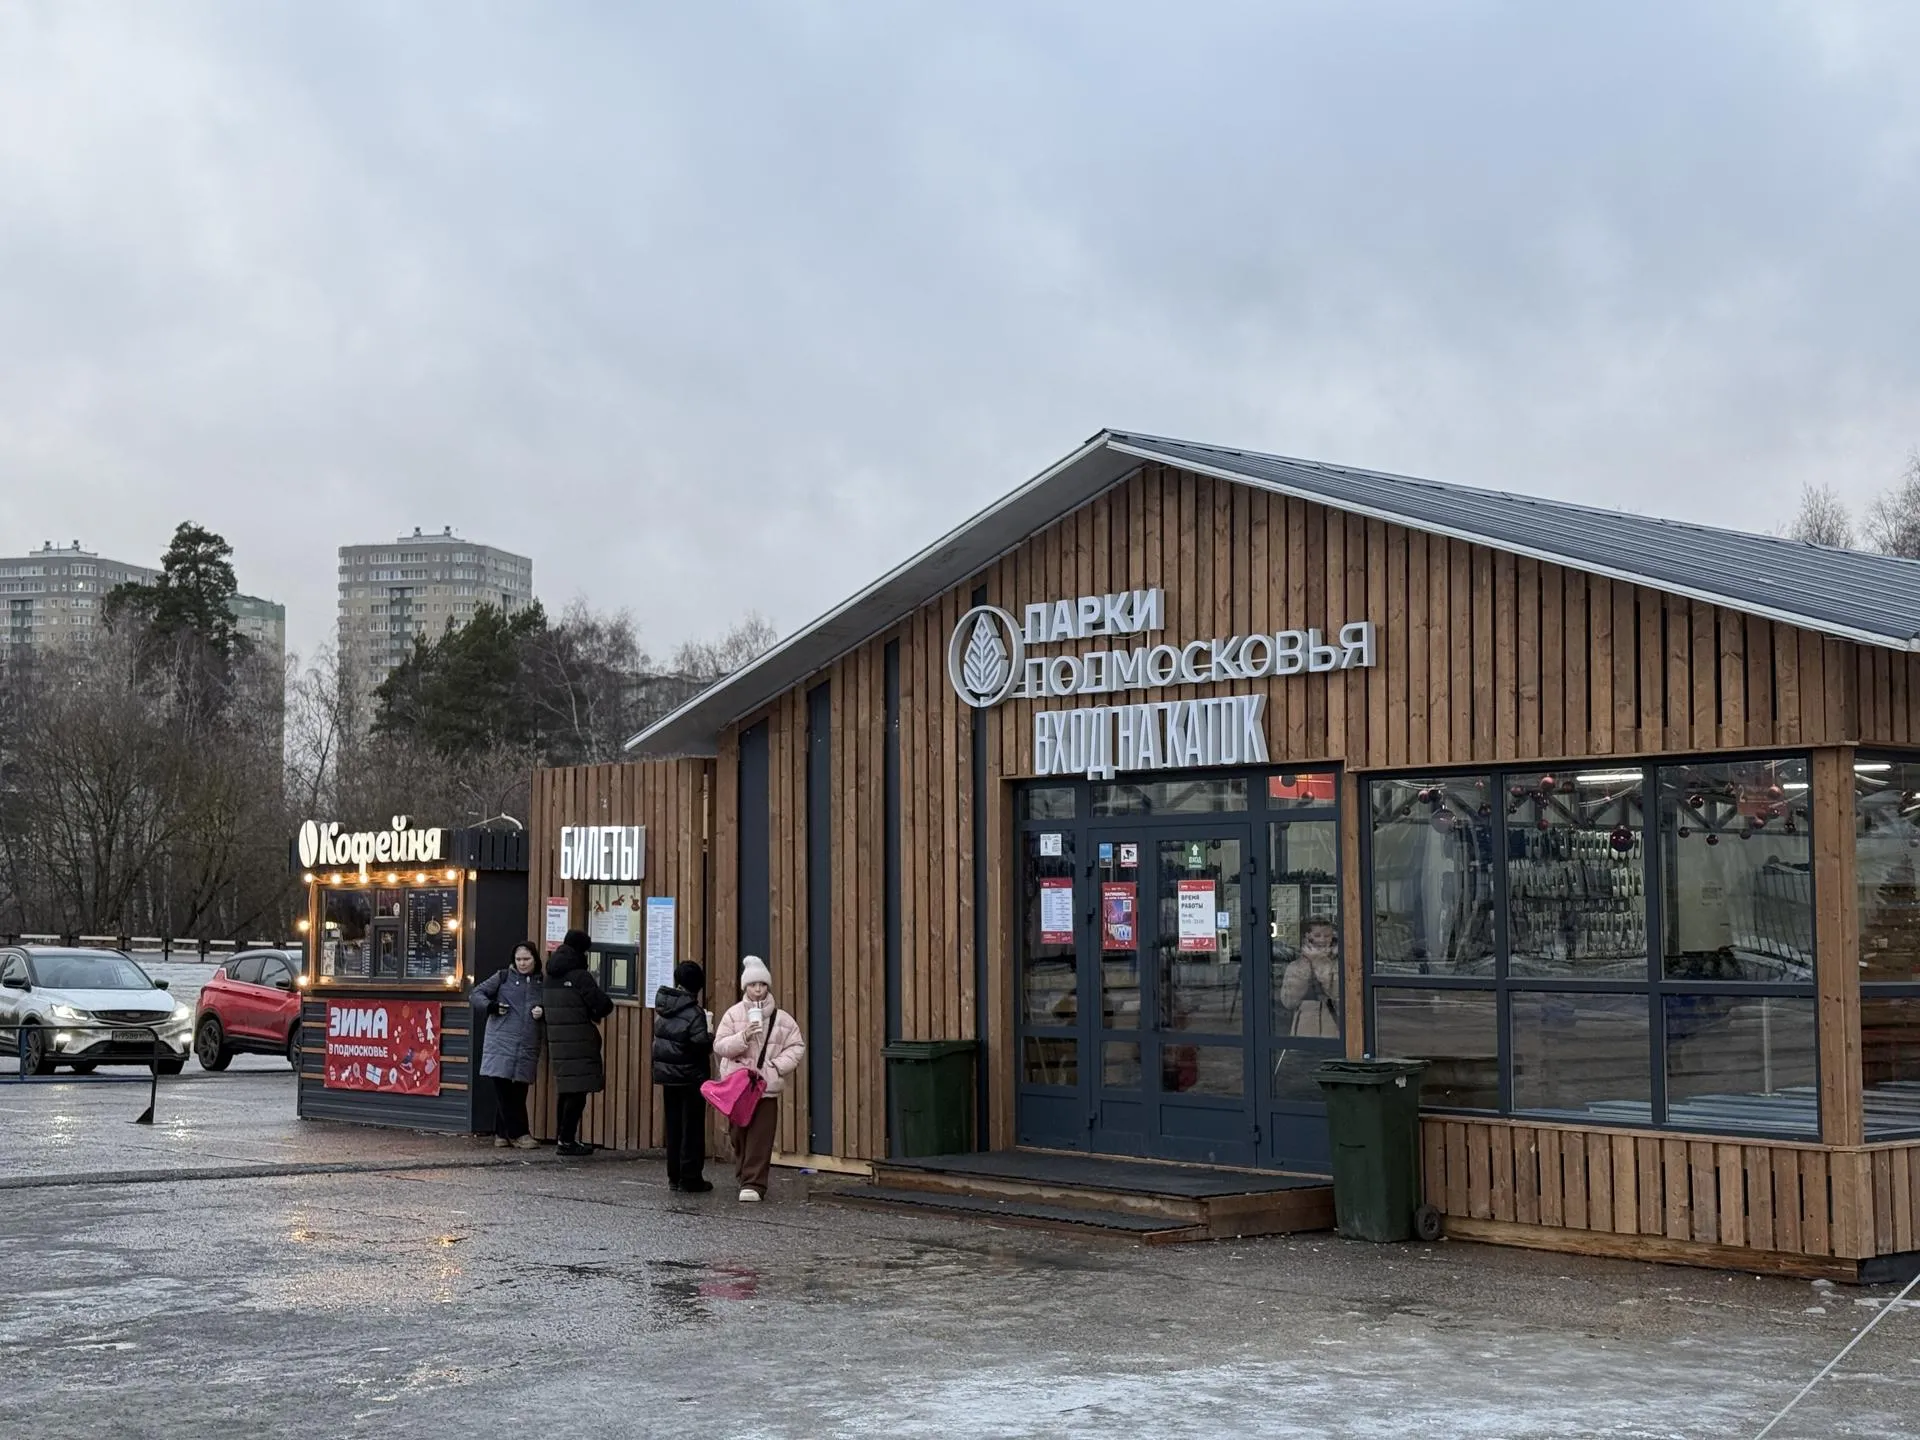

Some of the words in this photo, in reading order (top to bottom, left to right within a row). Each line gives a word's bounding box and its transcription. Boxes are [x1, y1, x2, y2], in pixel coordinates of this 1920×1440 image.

[1024, 588, 1164, 644] ПАРКИ
[1024, 621, 1376, 699] ПОДМОСКОВЬЯ
[1035, 706, 1116, 780] ВХОД
[1117, 702, 1164, 770] НА
[1166, 694, 1270, 767] КАТОК
[318, 815, 443, 876] Кофейня
[560, 825, 643, 881] БИЛЕТЫ
[328, 1043, 334, 1055] В
[333, 1044, 388, 1058] ПОДМОСКОВЬЕ
[329, 1006, 389, 1039] ЗИМА
